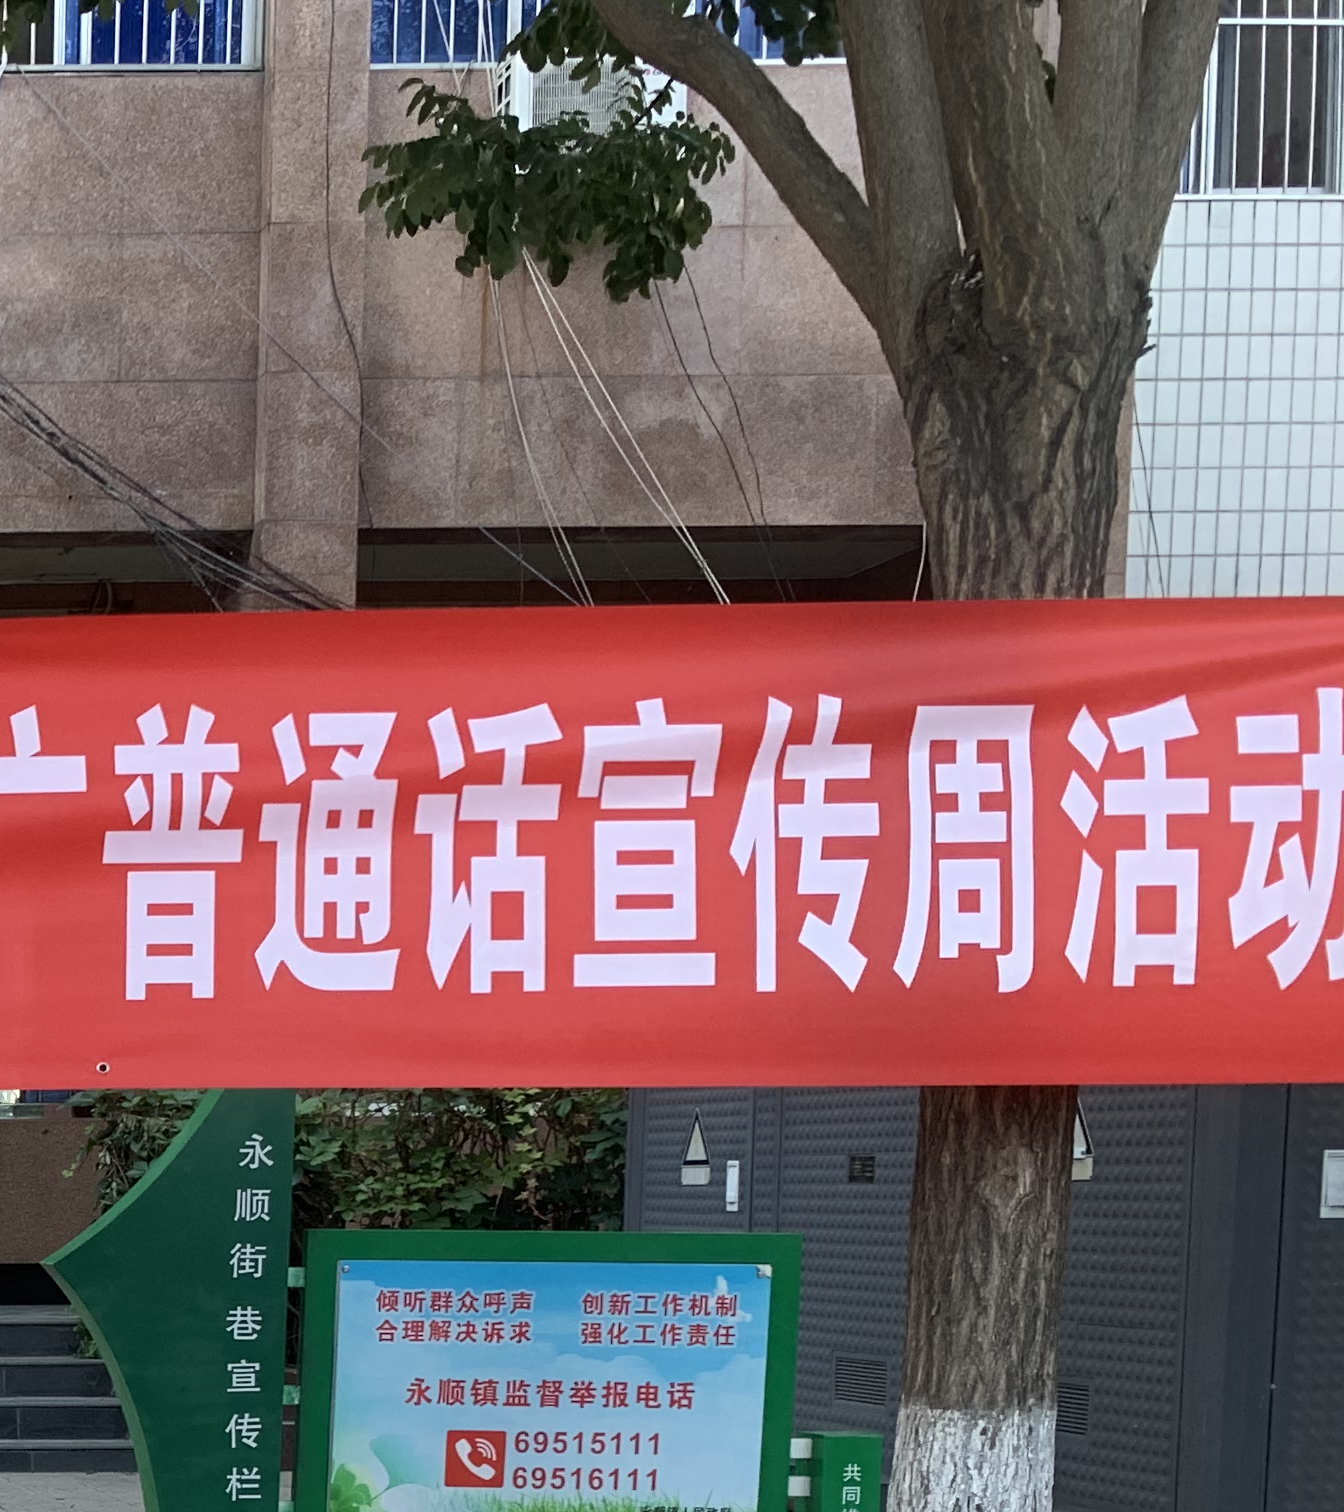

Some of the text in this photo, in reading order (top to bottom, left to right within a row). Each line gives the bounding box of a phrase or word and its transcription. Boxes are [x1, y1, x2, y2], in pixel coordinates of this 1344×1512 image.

[224, 1132, 275, 1502] 永顺街巷宣传栏
[375, 1290, 738, 1318] 倾听群众呼声 创新工作机制
[375, 1319, 737, 1347] 合理解决诉求 强化工作责任
[404, 1378, 697, 1410] 永顺镇监督举报电话
[513, 1431, 661, 1456] 69515111
[512, 1466, 659, 1491] 69516111
